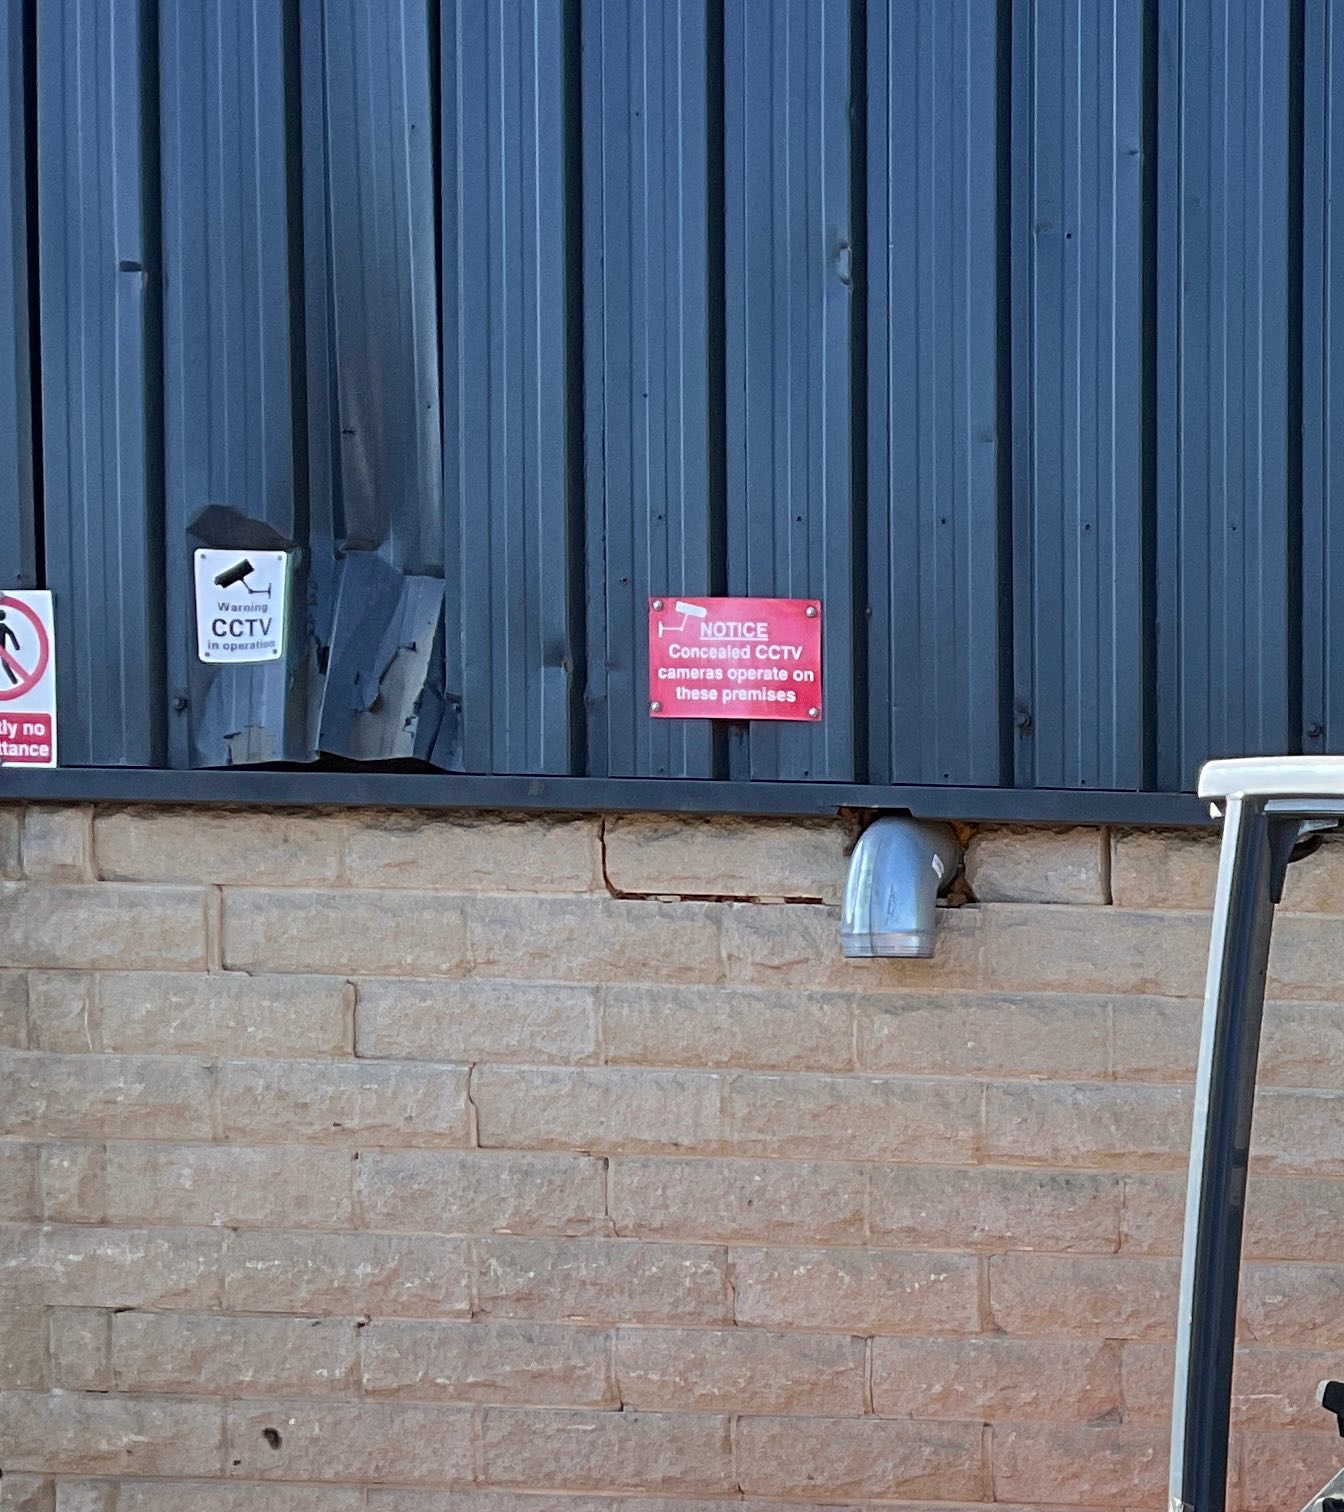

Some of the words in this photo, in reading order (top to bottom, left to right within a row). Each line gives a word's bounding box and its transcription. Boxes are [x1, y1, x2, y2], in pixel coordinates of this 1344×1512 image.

[217, 602, 268, 613] Warning
[212, 618, 272, 637] CCTV
[700, 622, 768, 639] NOTICE
[207, 640, 219, 650] in
[222, 640, 275, 652] operation
[669, 644, 750, 659] Concealed
[756, 645, 803, 660] CCTV
[658, 667, 723, 680] cameras
[727, 667, 788, 683] operate
[792, 669, 815, 682] on
[676, 686, 718, 701] these
[722, 687, 797, 704] premises
[22, 722, 46, 737] no
